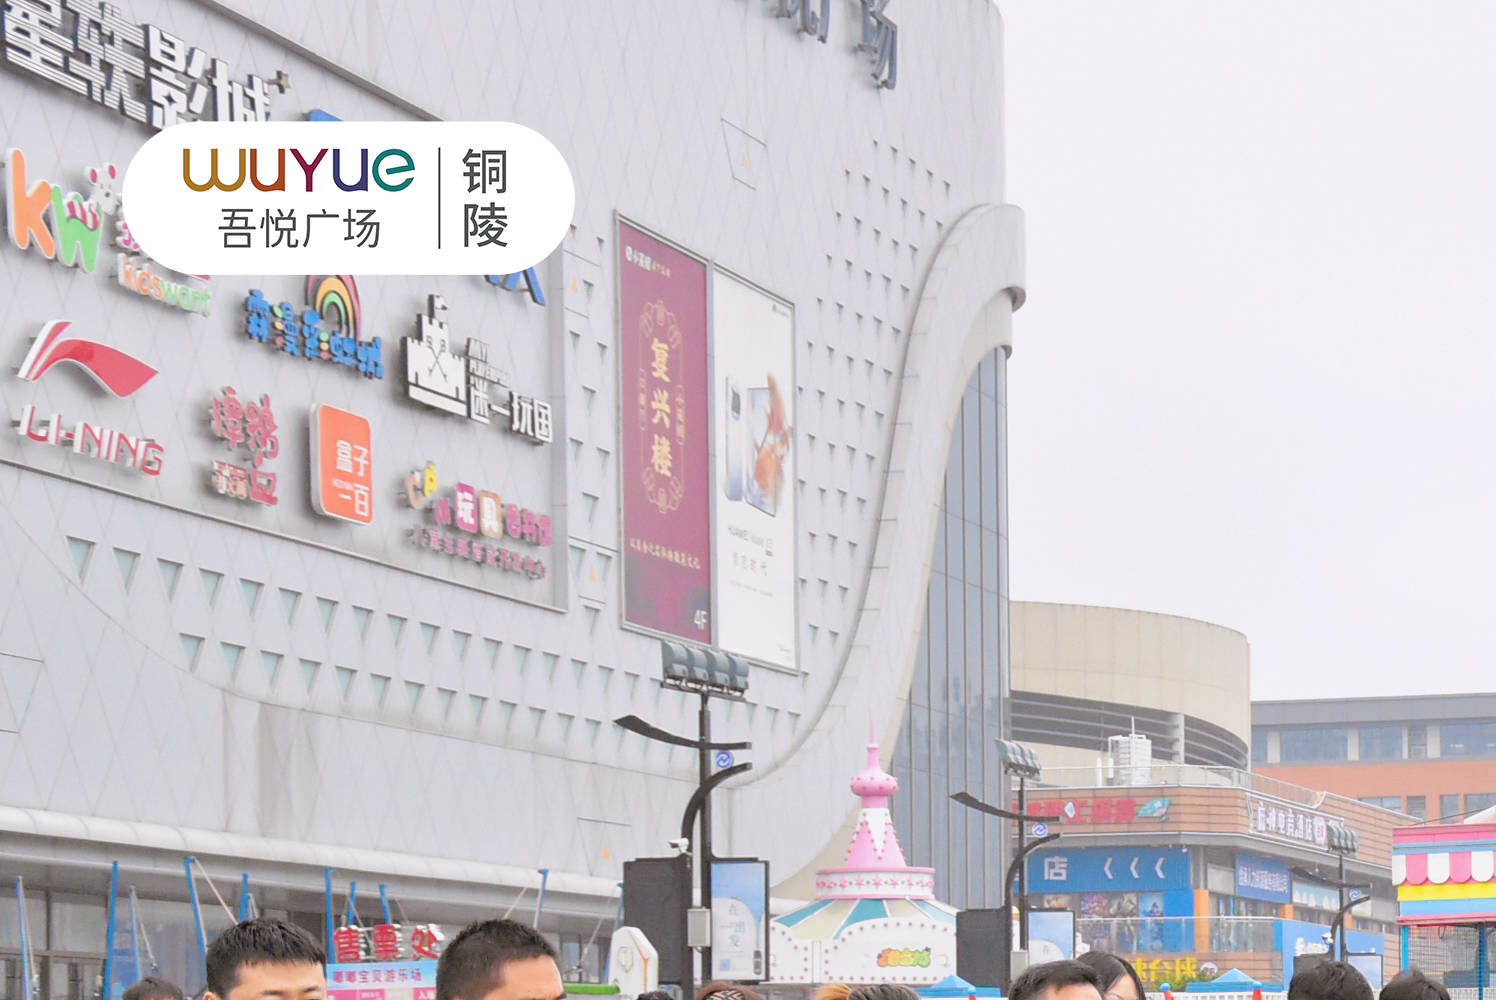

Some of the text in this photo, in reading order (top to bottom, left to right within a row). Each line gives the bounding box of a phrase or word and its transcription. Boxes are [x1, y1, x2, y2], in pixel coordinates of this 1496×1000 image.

[650, 338, 673, 478] 复兴楼
[21, 405, 164, 476] LI-NING
[336, 439, 370, 477] 盒子
[339, 483, 370, 517] 一百
[1044, 855, 1068, 881] 店
[334, 923, 444, 962] 售票处
